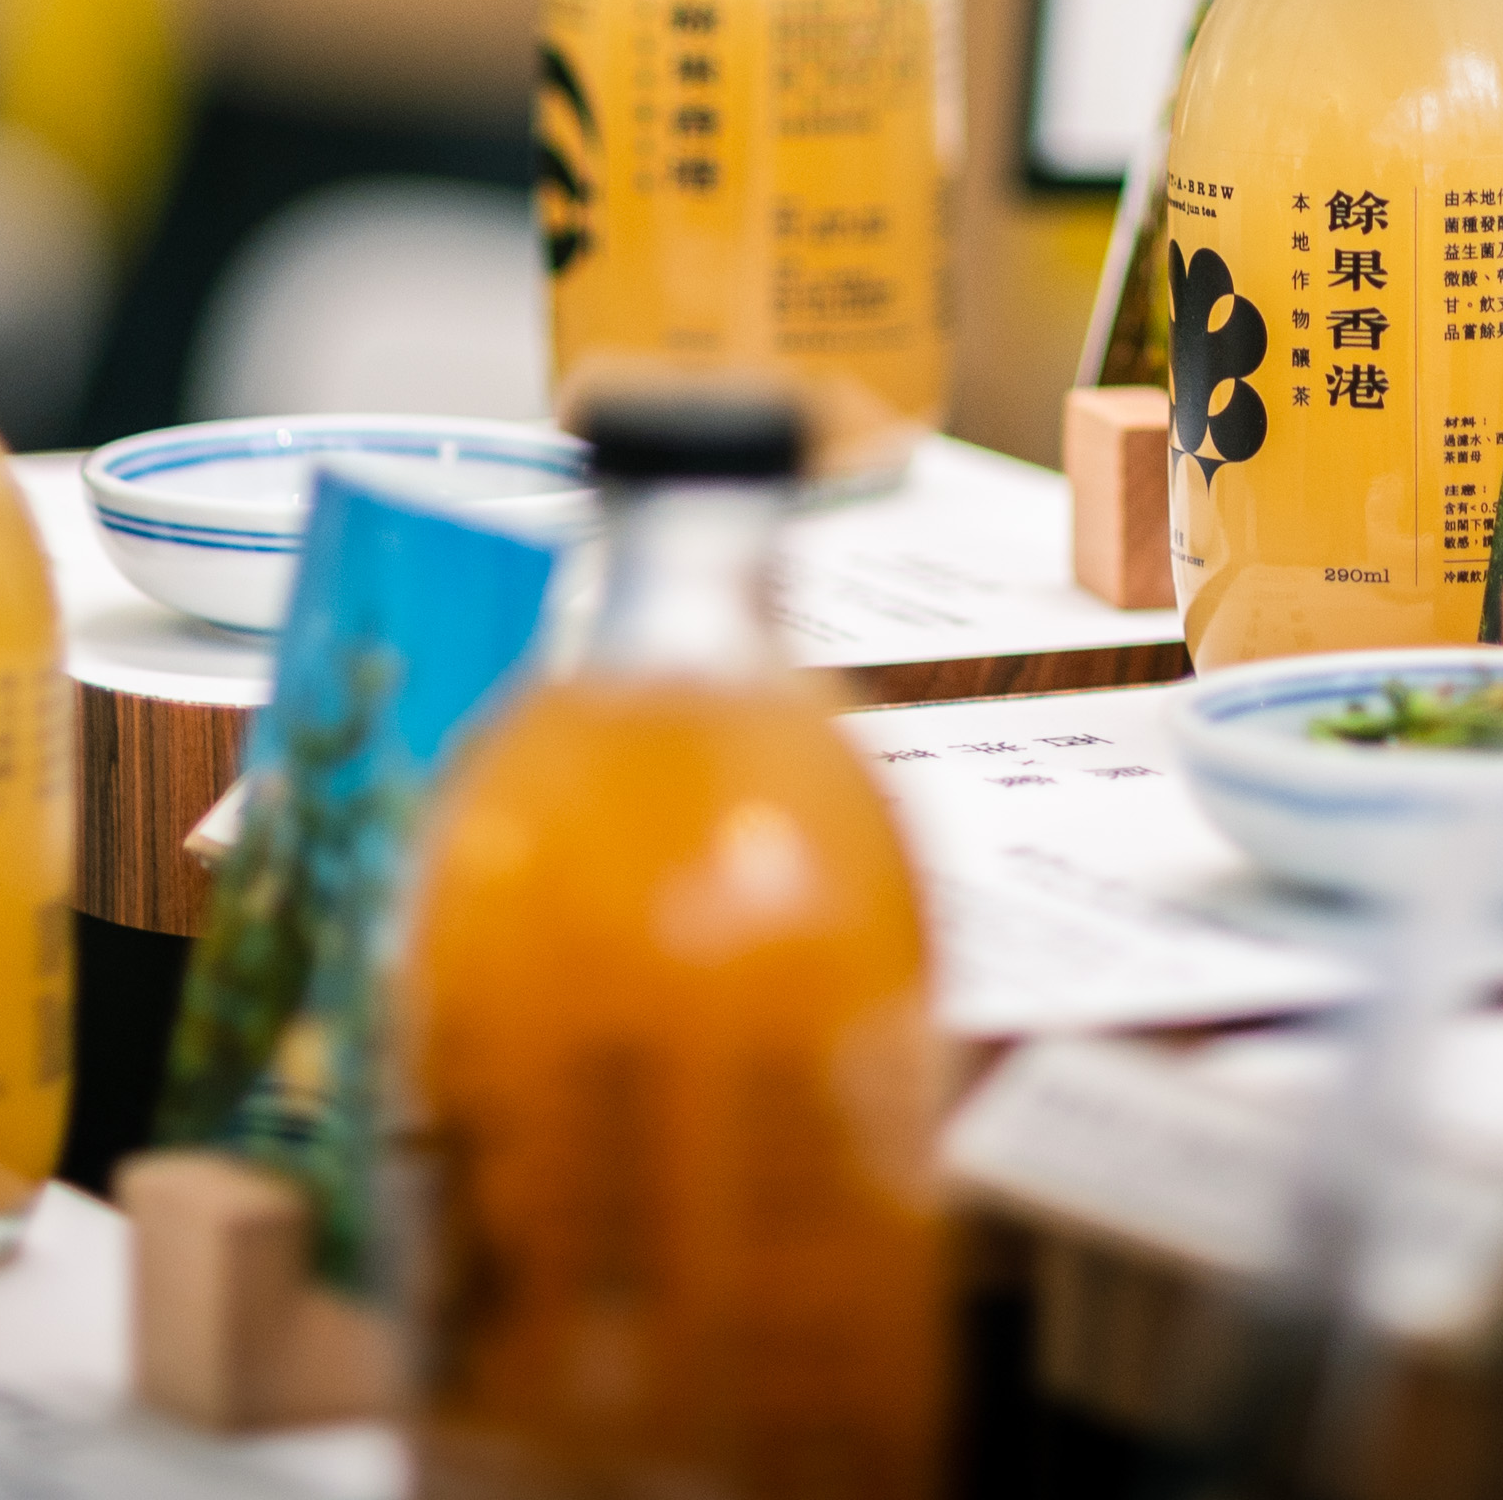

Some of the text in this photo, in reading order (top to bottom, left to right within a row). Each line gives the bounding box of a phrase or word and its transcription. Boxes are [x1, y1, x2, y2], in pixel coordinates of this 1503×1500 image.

[1187, 202, 1200, 216] jun
[1202, 205, 1217, 218] tea
[1291, 193, 1311, 407] 本地作物釀茶
[1324, 189, 1391, 410] 餘果香港
[1324, 567, 1390, 584] 290ml
